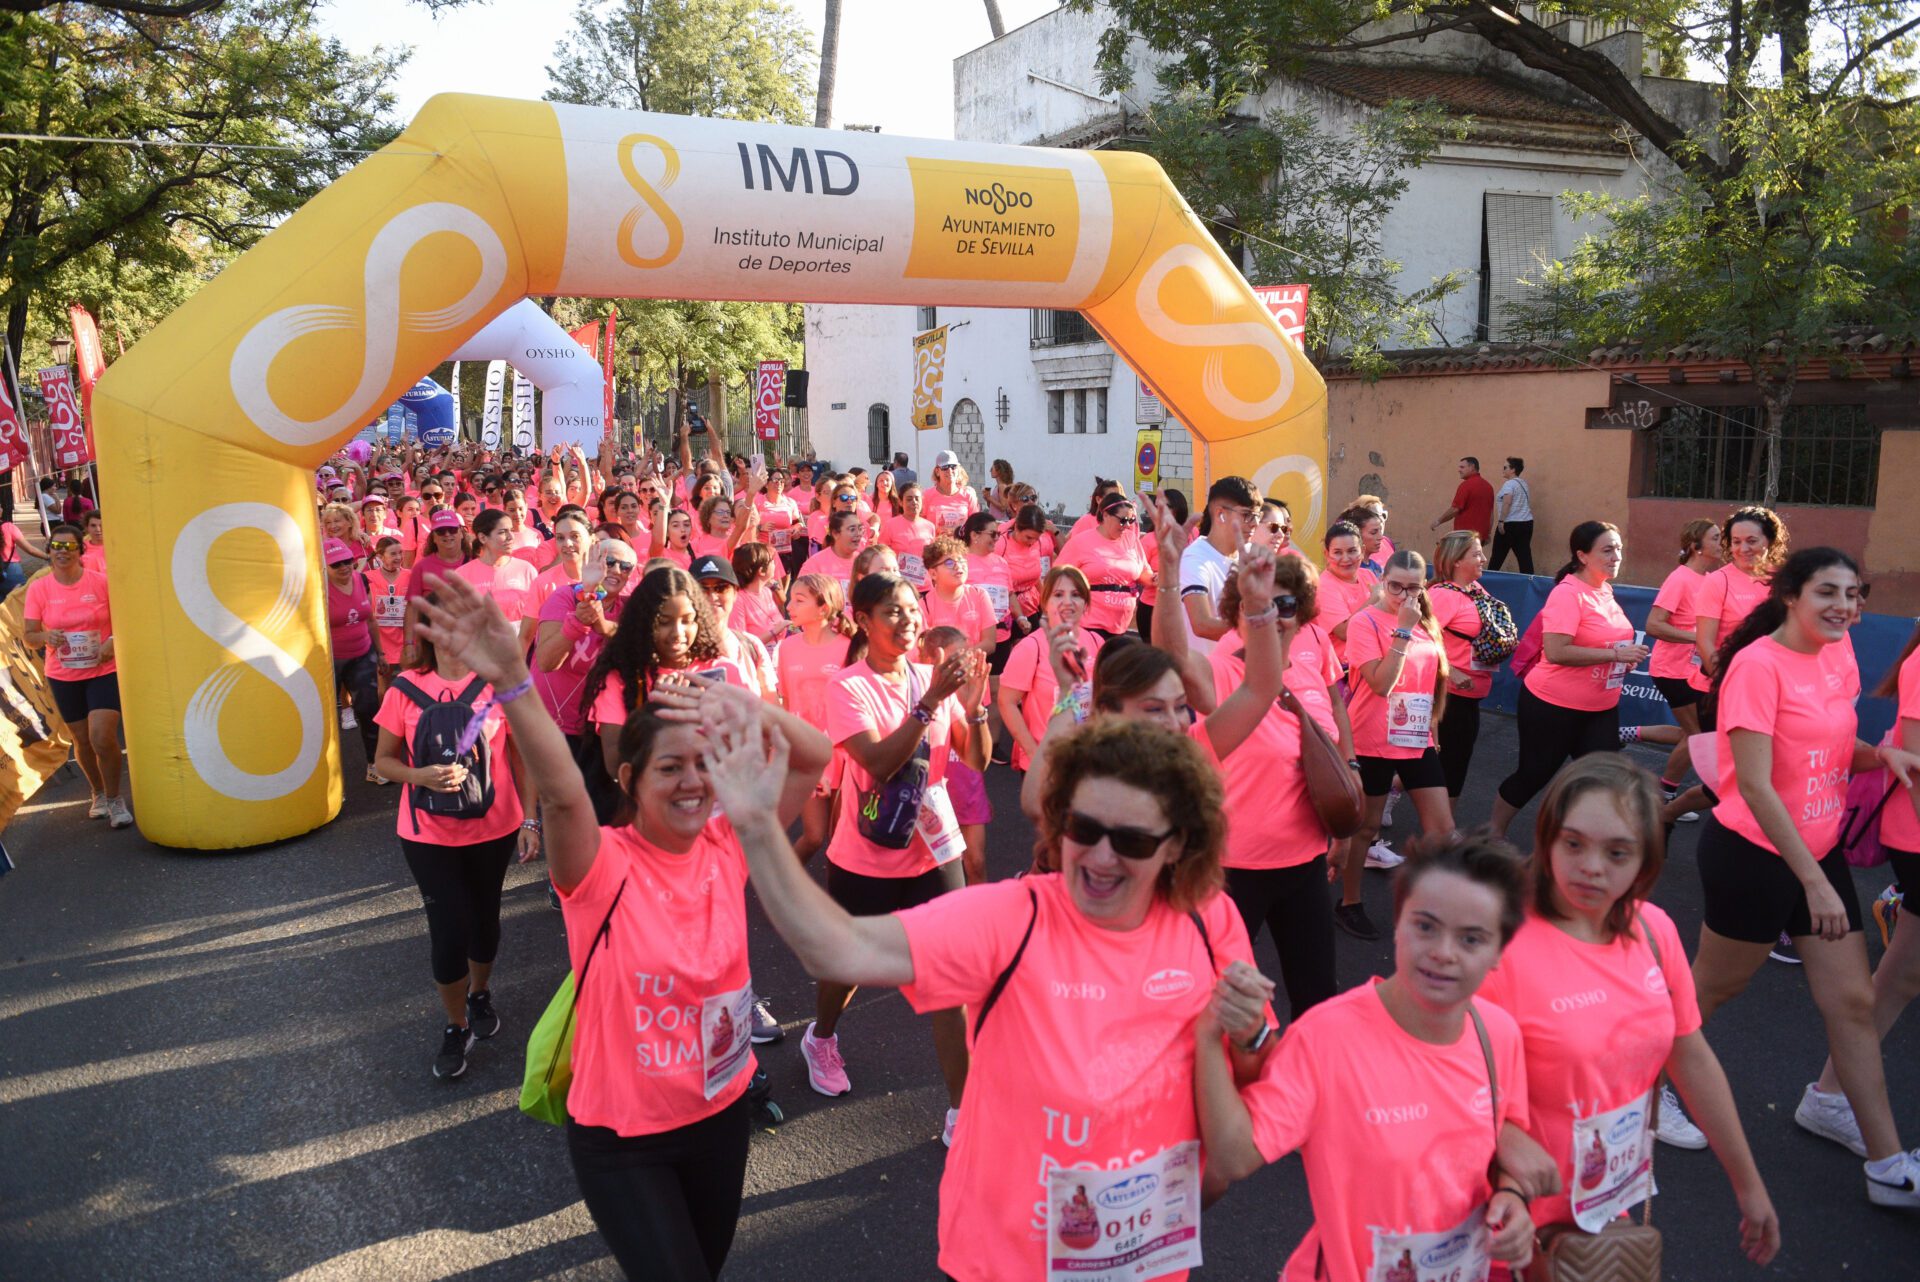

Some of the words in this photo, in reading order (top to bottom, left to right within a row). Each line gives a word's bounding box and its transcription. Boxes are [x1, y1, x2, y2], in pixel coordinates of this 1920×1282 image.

[737, 142, 859, 196] IMD
[942, 214, 1055, 237] AYUNTAMIENTO
[713, 226, 791, 248] Instituto
[797, 231, 884, 255] Municipal
[957, 239, 977, 254] DE
[981, 237, 1034, 256] SEVILLA
[738, 254, 762, 270] de
[768, 255, 852, 275] Deportes
[918, 331, 944, 348] SEVILLA
[526, 348, 575, 359] OYSHO
[761, 363, 784, 371] SEVILLA
[485, 369, 502, 447] OYSHO
[554, 415, 599, 427] OYSHO
[1410, 714, 1427, 724] 016
[1808, 749, 1830, 769] TU
[1807, 767, 1850, 796] DORSA
[1802, 794, 1842, 820] SUMA
[635, 972, 674, 996] TU
[1551, 989, 1607, 1012] OYSHO
[636, 1006, 696, 1032] DOR
[636, 1041, 701, 1067] SUM
[1366, 1104, 1428, 1124] OYSHO
[1042, 1106, 1090, 1147] TU
[1610, 1144, 1636, 1172] 016
[1105, 1208, 1152, 1239] 016
[1115, 1233, 1144, 1253] 6487
